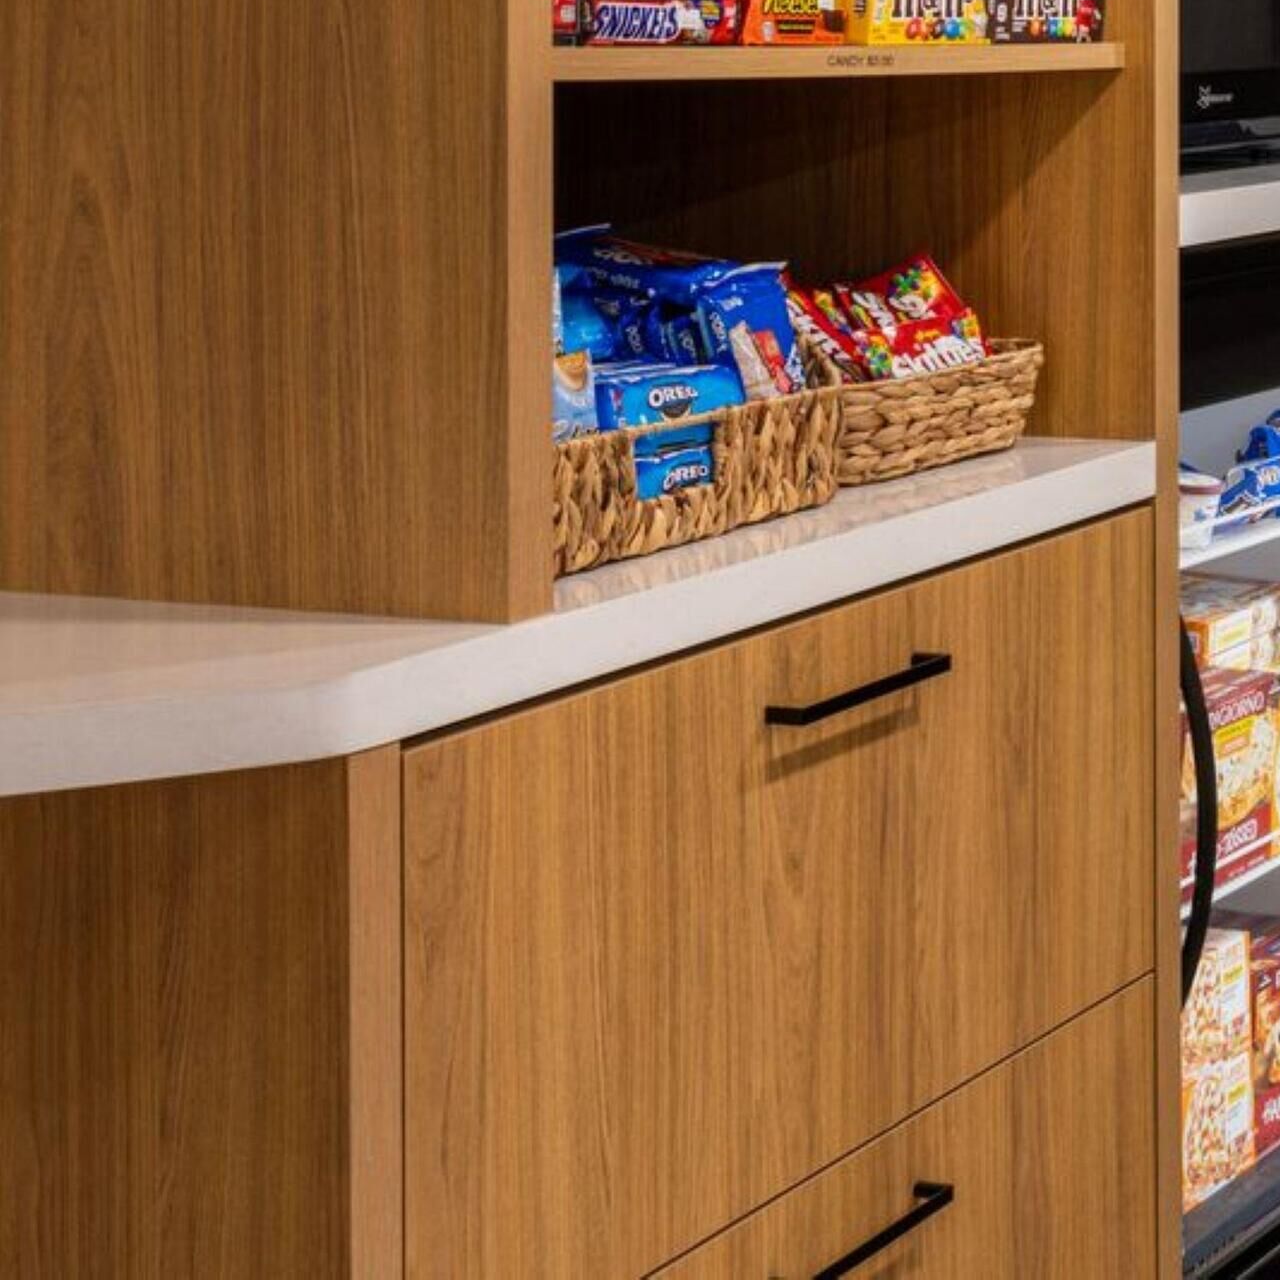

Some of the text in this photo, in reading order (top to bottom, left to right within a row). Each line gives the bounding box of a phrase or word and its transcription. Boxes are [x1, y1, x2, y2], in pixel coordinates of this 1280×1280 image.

[827, 56, 865, 67] CANDY
[891, 334, 987, 379] Skittles
[664, 465, 709, 492] OREO
